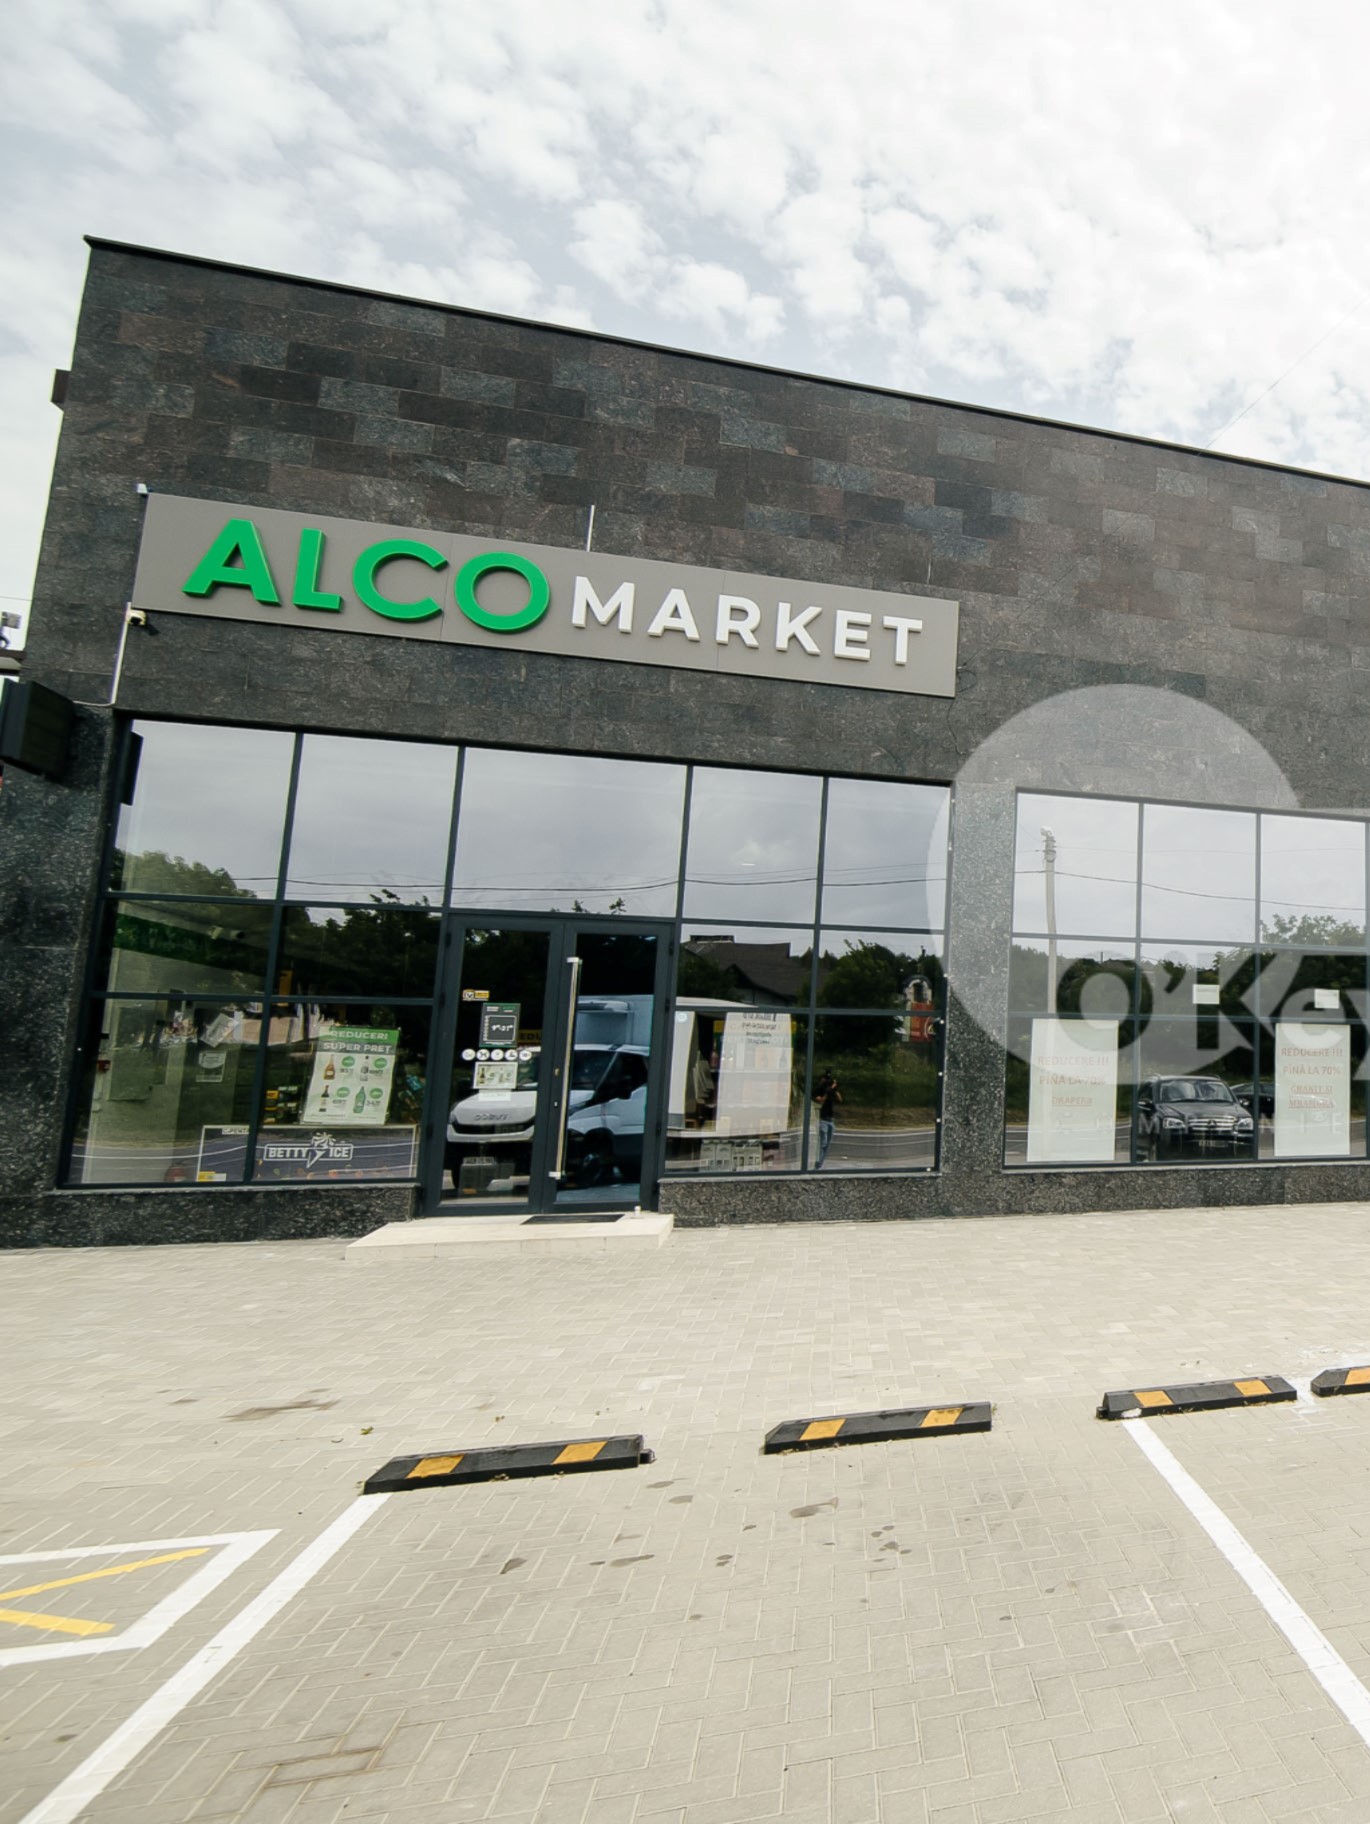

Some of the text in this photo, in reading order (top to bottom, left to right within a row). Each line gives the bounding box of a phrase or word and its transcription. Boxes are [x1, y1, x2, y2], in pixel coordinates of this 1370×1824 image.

[181, 518, 924, 666] ALCO MARKET
[323, 1042, 361, 1051] SUPER
[1280, 1047, 1331, 1057] REDUCERE
[1038, 1056, 1096, 1067] REDUCERE
[1308, 1066, 1320, 1075] LA
[268, 1147, 350, 1158] BETTY ICE
